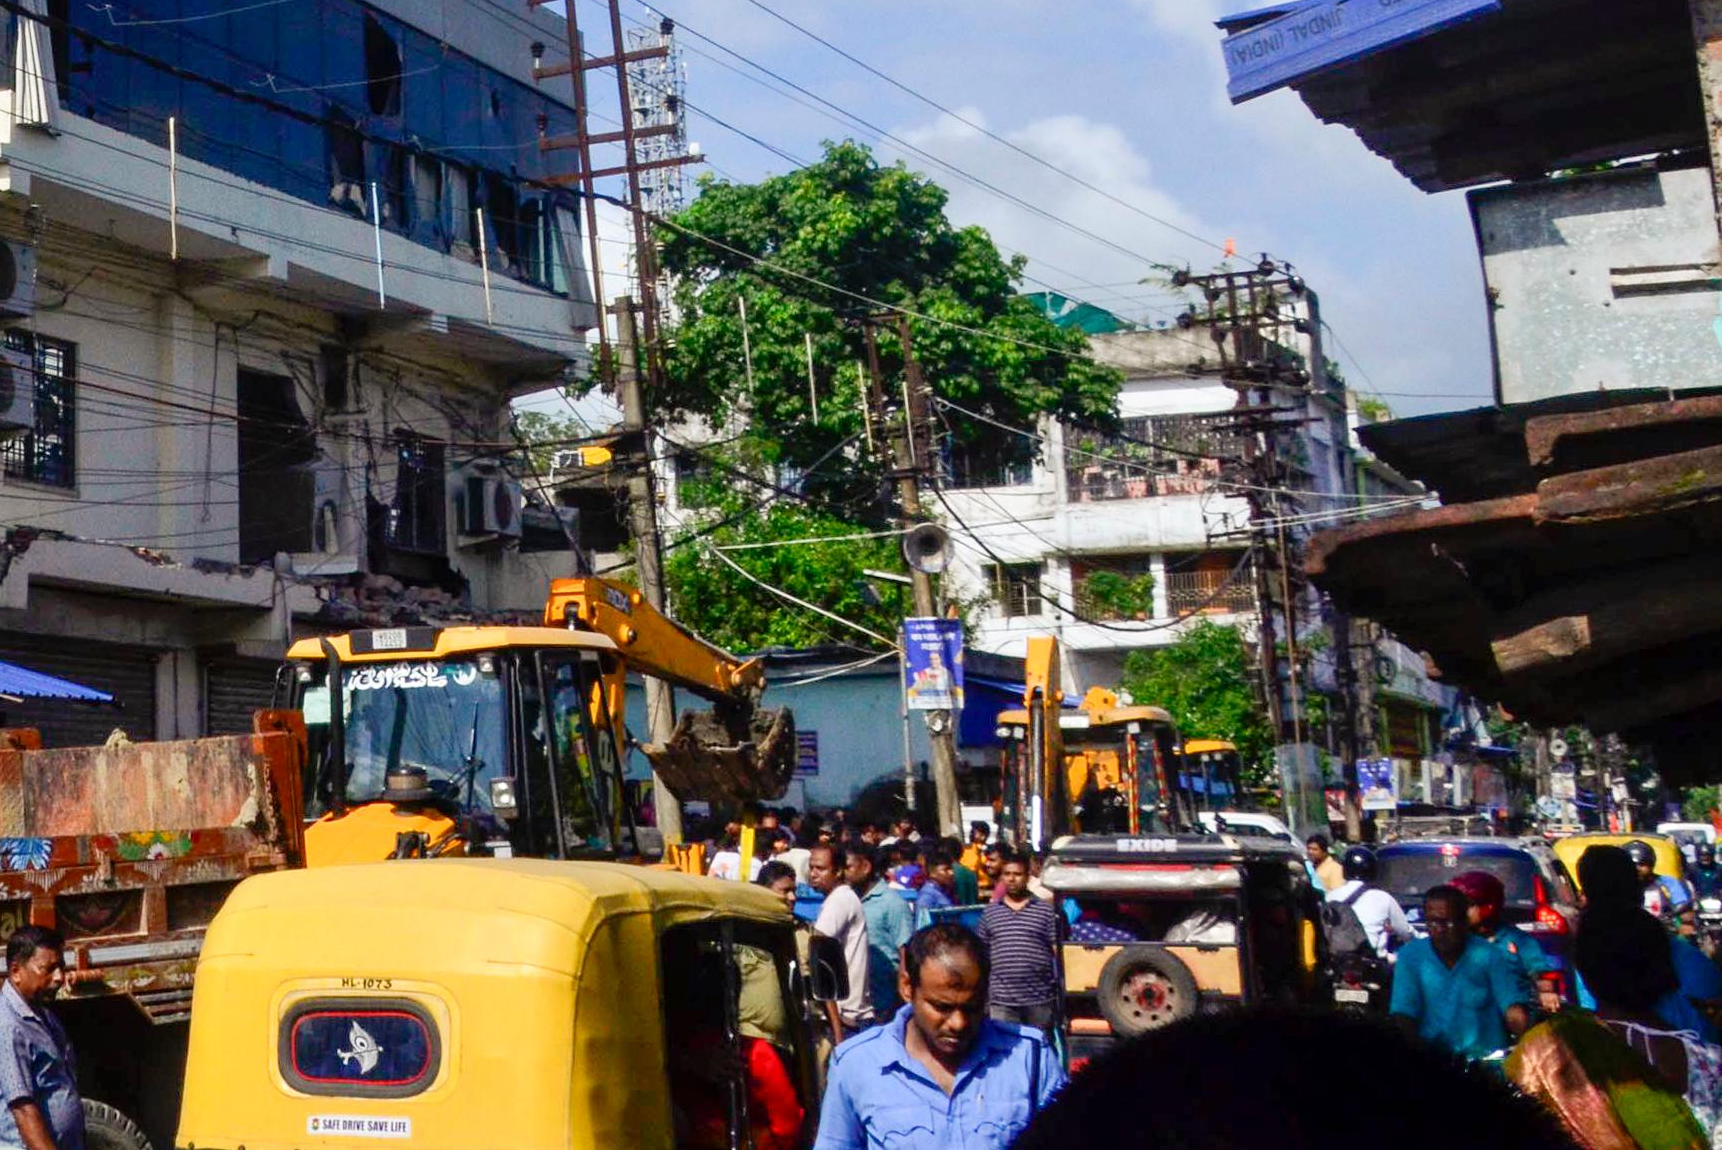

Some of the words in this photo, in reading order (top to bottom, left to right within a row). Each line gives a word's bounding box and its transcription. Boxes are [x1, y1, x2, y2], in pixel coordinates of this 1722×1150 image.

[1289, 7, 1345, 42] JINDAL
[1117, 838, 1178, 852] EXIDE
[322, 1119, 340, 1131] SAFE
[342, 1120, 365, 1132] DRIVE
[367, 1121, 388, 1133] SAVE
[390, 1122, 407, 1133] LIFE
